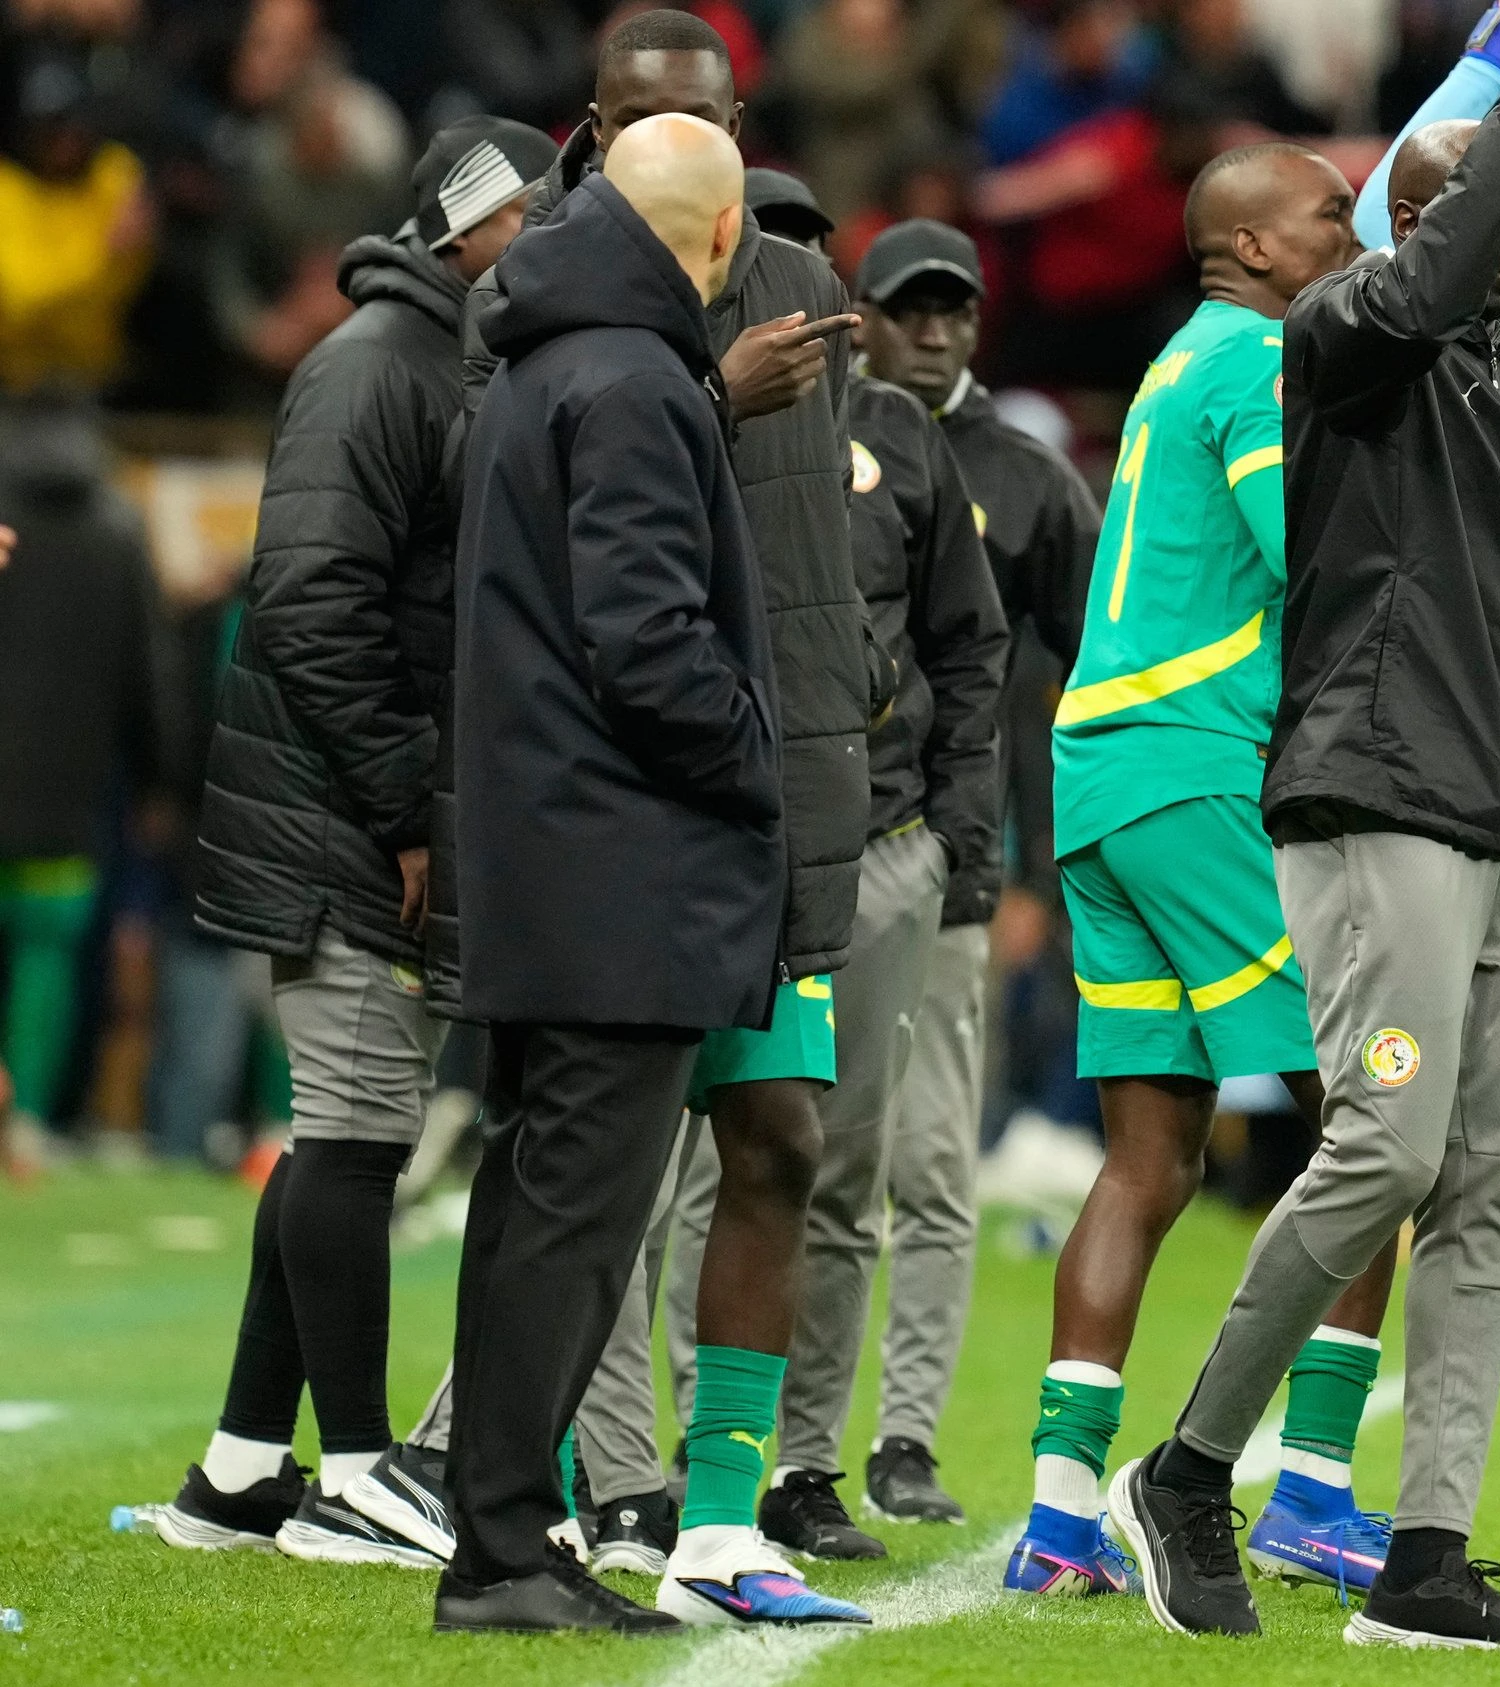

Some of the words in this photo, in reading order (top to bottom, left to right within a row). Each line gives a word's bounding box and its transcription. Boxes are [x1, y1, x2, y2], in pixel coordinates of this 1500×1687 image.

[1108, 422, 1149, 623] 1
[1266, 1540, 1299, 1554] AIR
[1298, 1550, 1323, 1563] ZOOM
